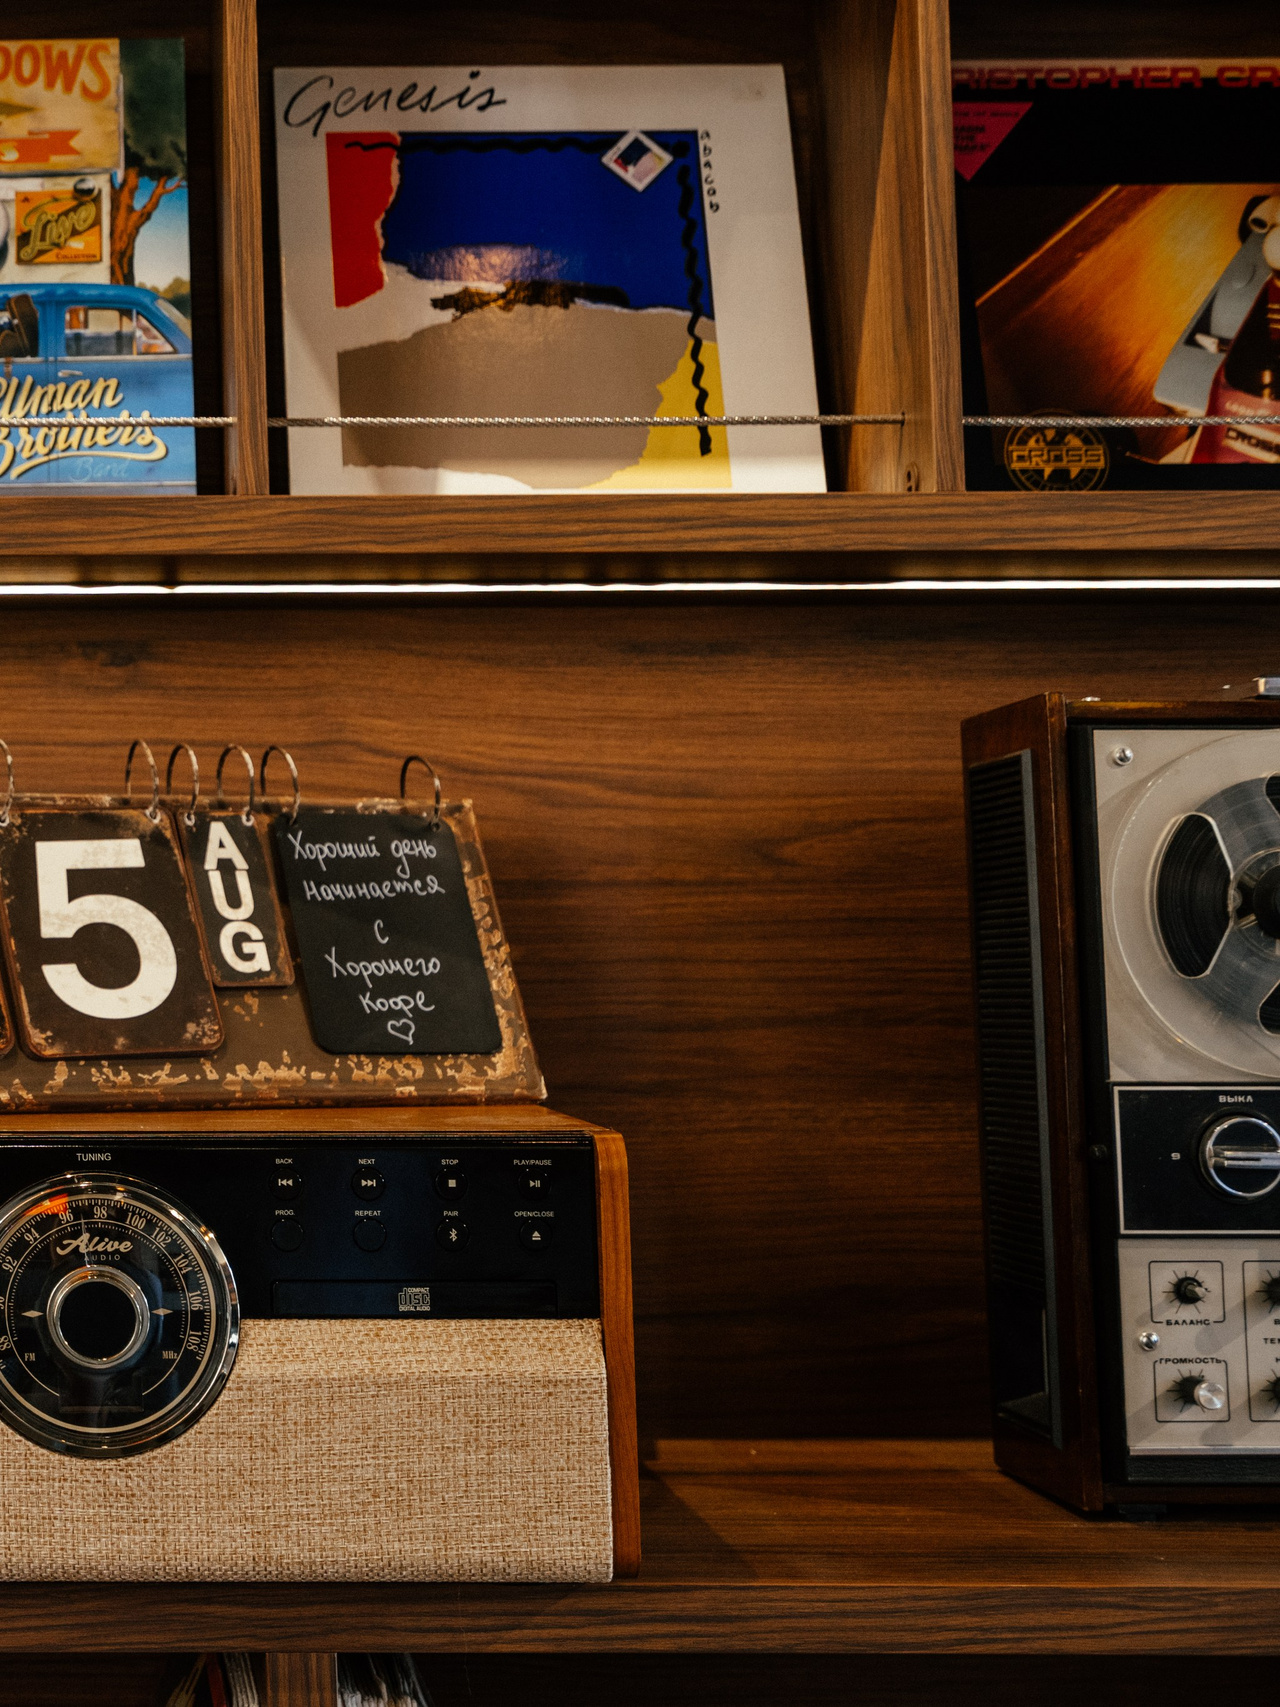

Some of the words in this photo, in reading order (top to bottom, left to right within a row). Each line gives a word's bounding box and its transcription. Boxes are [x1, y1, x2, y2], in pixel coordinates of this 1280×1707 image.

[283, 70, 507, 137] Genesis
[1010, 447, 1105, 469] CROSS
[287, 830, 381, 871] Хороший
[390, 838, 437, 878] день
[204, 821, 271, 973] AUG
[324, 946, 441, 988] Хорошего
[1218, 1095, 1254, 1103] ВЫКЛ
[76, 1152, 112, 1162] TUNING
[58, 1209, 74, 1225] 96
[93, 1205, 108, 1219] 98
[124, 1211, 148, 1231] 100
[513, 1210, 555, 1218] OPEN/CLOSE
[23, 1227, 41, 1245] 94
[55, 1232, 134, 1256] Alive
[150, 1227, 173, 1248] 102
[1, 1255, 19, 1274] 92
[172, 1252, 190, 1276] 104
[188, 1289, 204, 1312] 106
[186, 1329, 203, 1352] 108
[24, 1353, 36, 1361] FM
[162, 1350, 179, 1360] MHz
